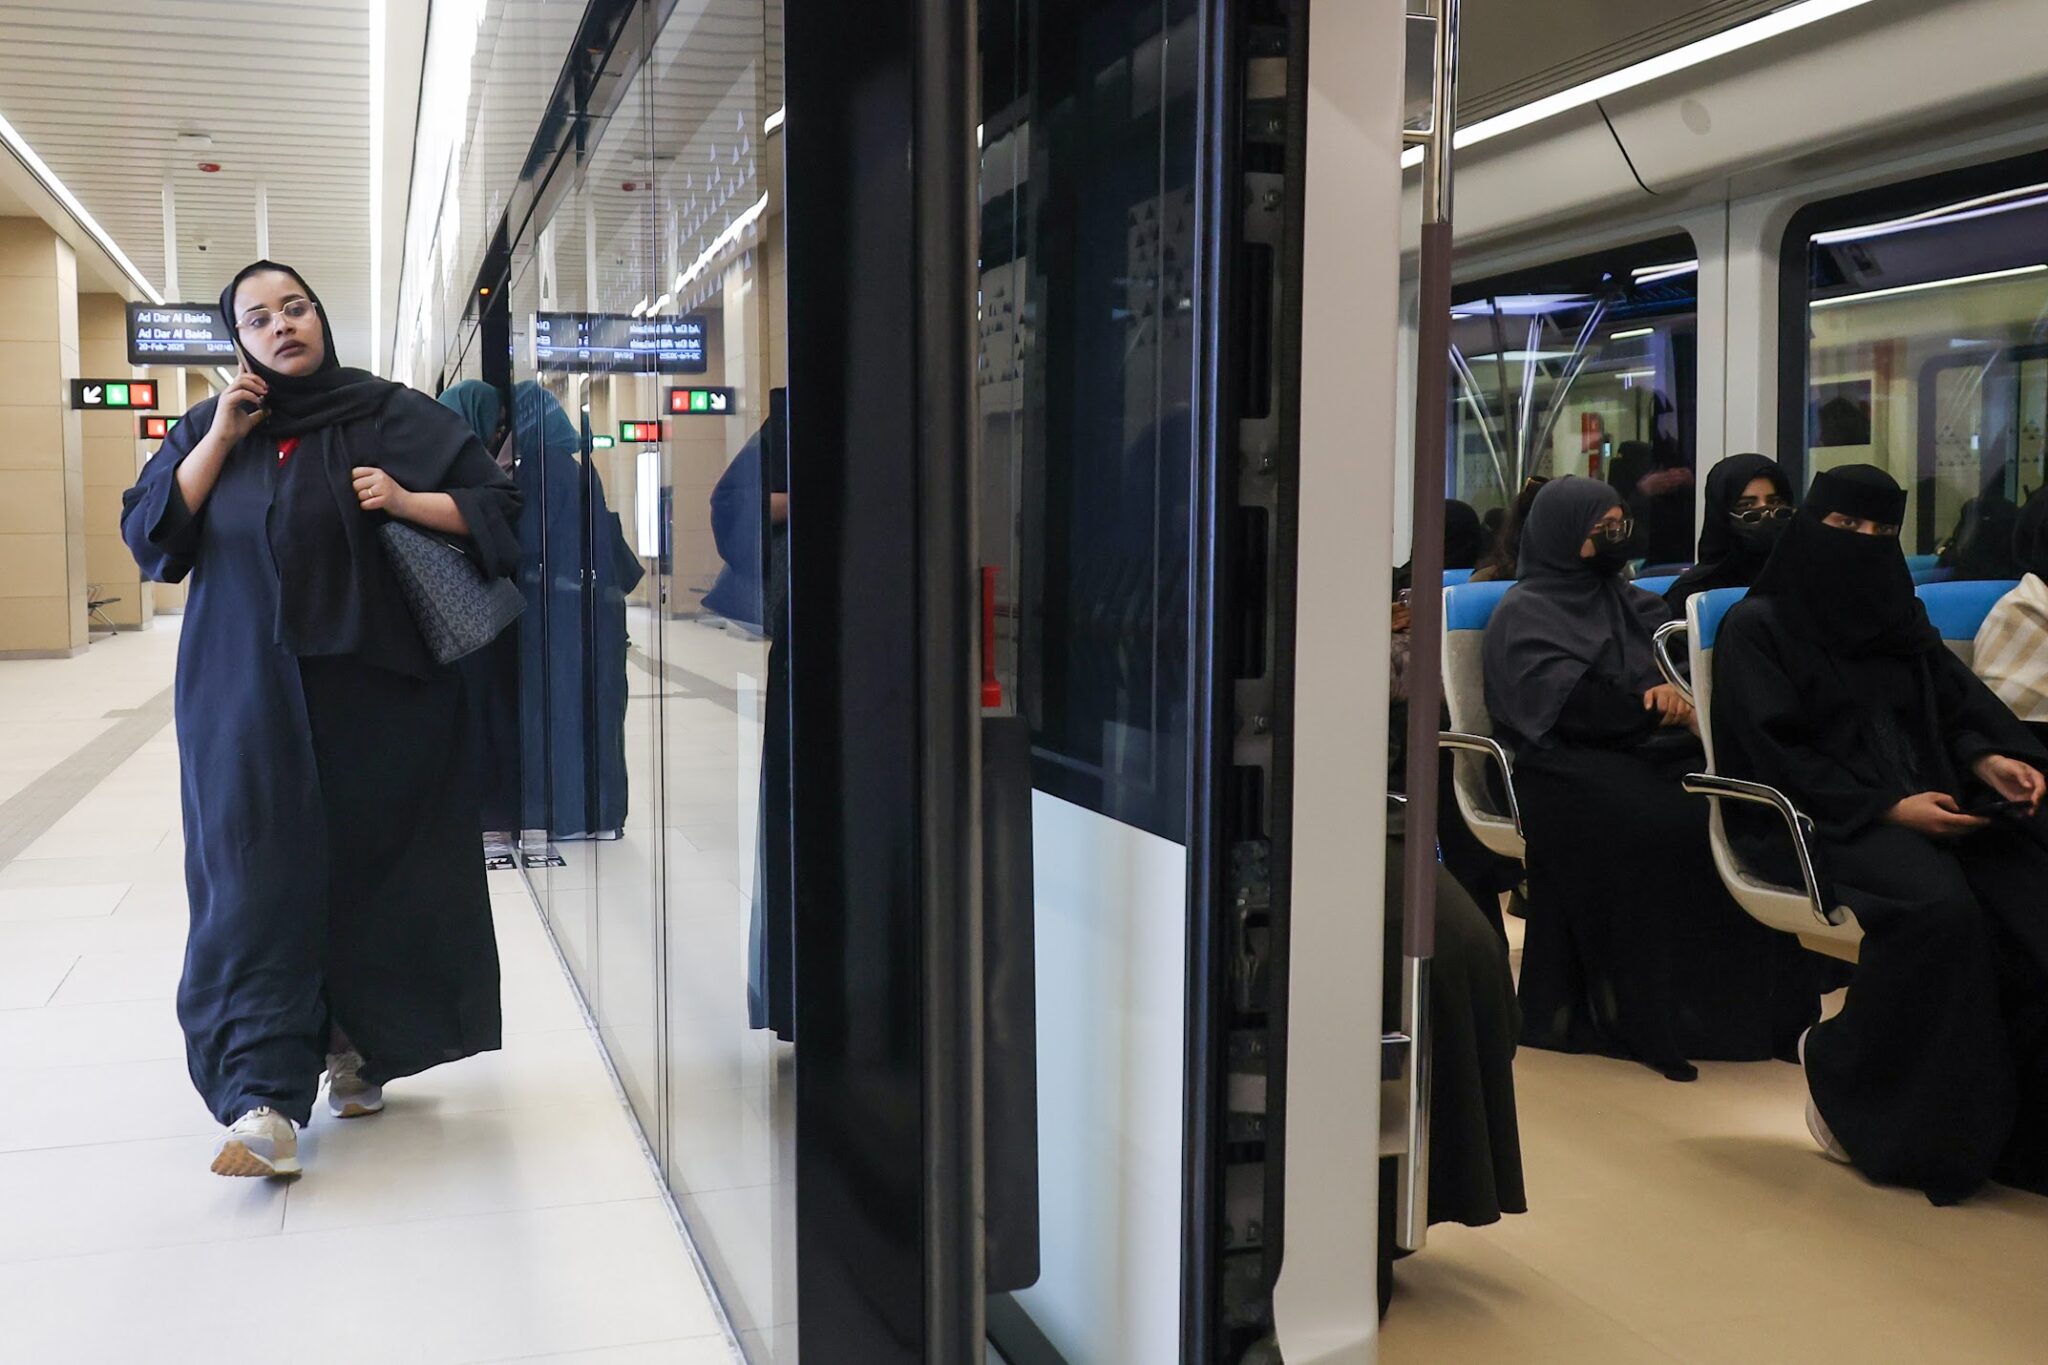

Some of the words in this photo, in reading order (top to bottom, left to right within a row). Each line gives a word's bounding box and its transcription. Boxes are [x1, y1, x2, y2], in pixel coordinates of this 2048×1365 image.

[138, 312, 151, 322] Ad
[153, 312, 171, 323] Dar
[172, 313, 182, 323] Al
[184, 312, 212, 323] Baida
[138, 328, 152, 339] Ad
[153, 328, 171, 339] Dar
[173, 328, 183, 339] Al
[185, 329, 212, 339] Baida
[139, 343, 185, 351] 20-Feb-2025
